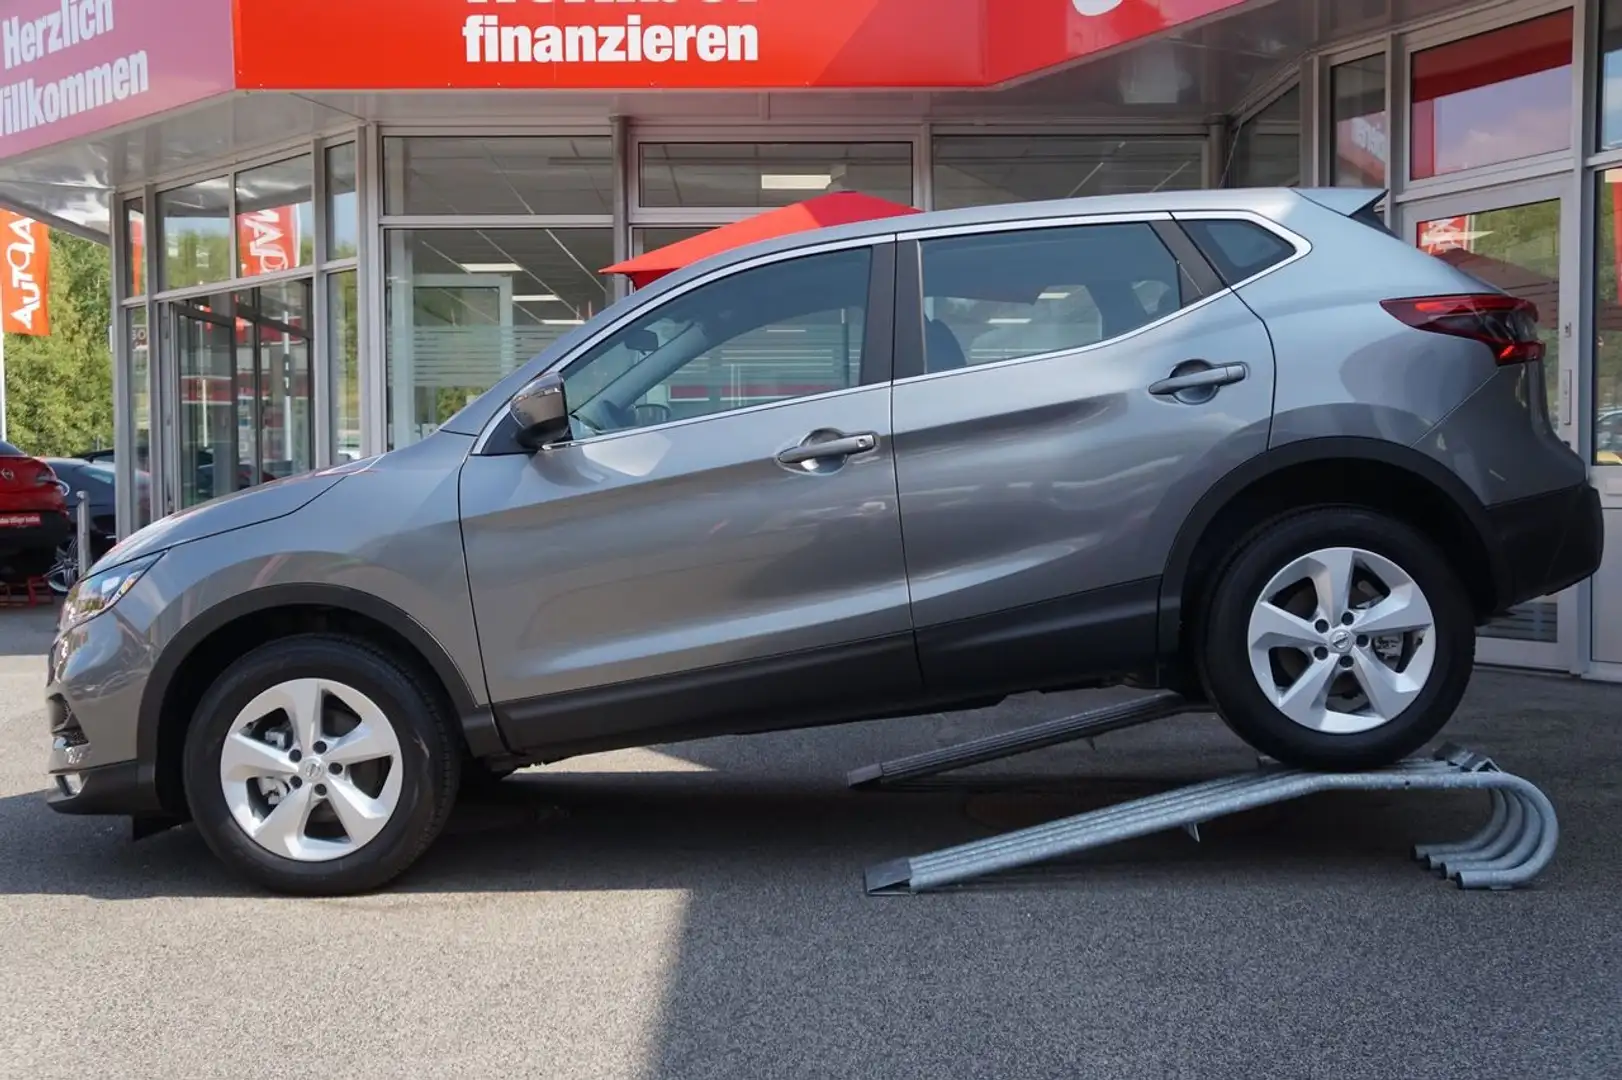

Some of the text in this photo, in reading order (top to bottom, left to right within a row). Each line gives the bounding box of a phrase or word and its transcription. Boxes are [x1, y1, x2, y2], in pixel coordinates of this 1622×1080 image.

[2, 0, 114, 70] Herzlich
[462, 14, 759, 63] finanzieren
[6, 211, 41, 330] AUTOLA
